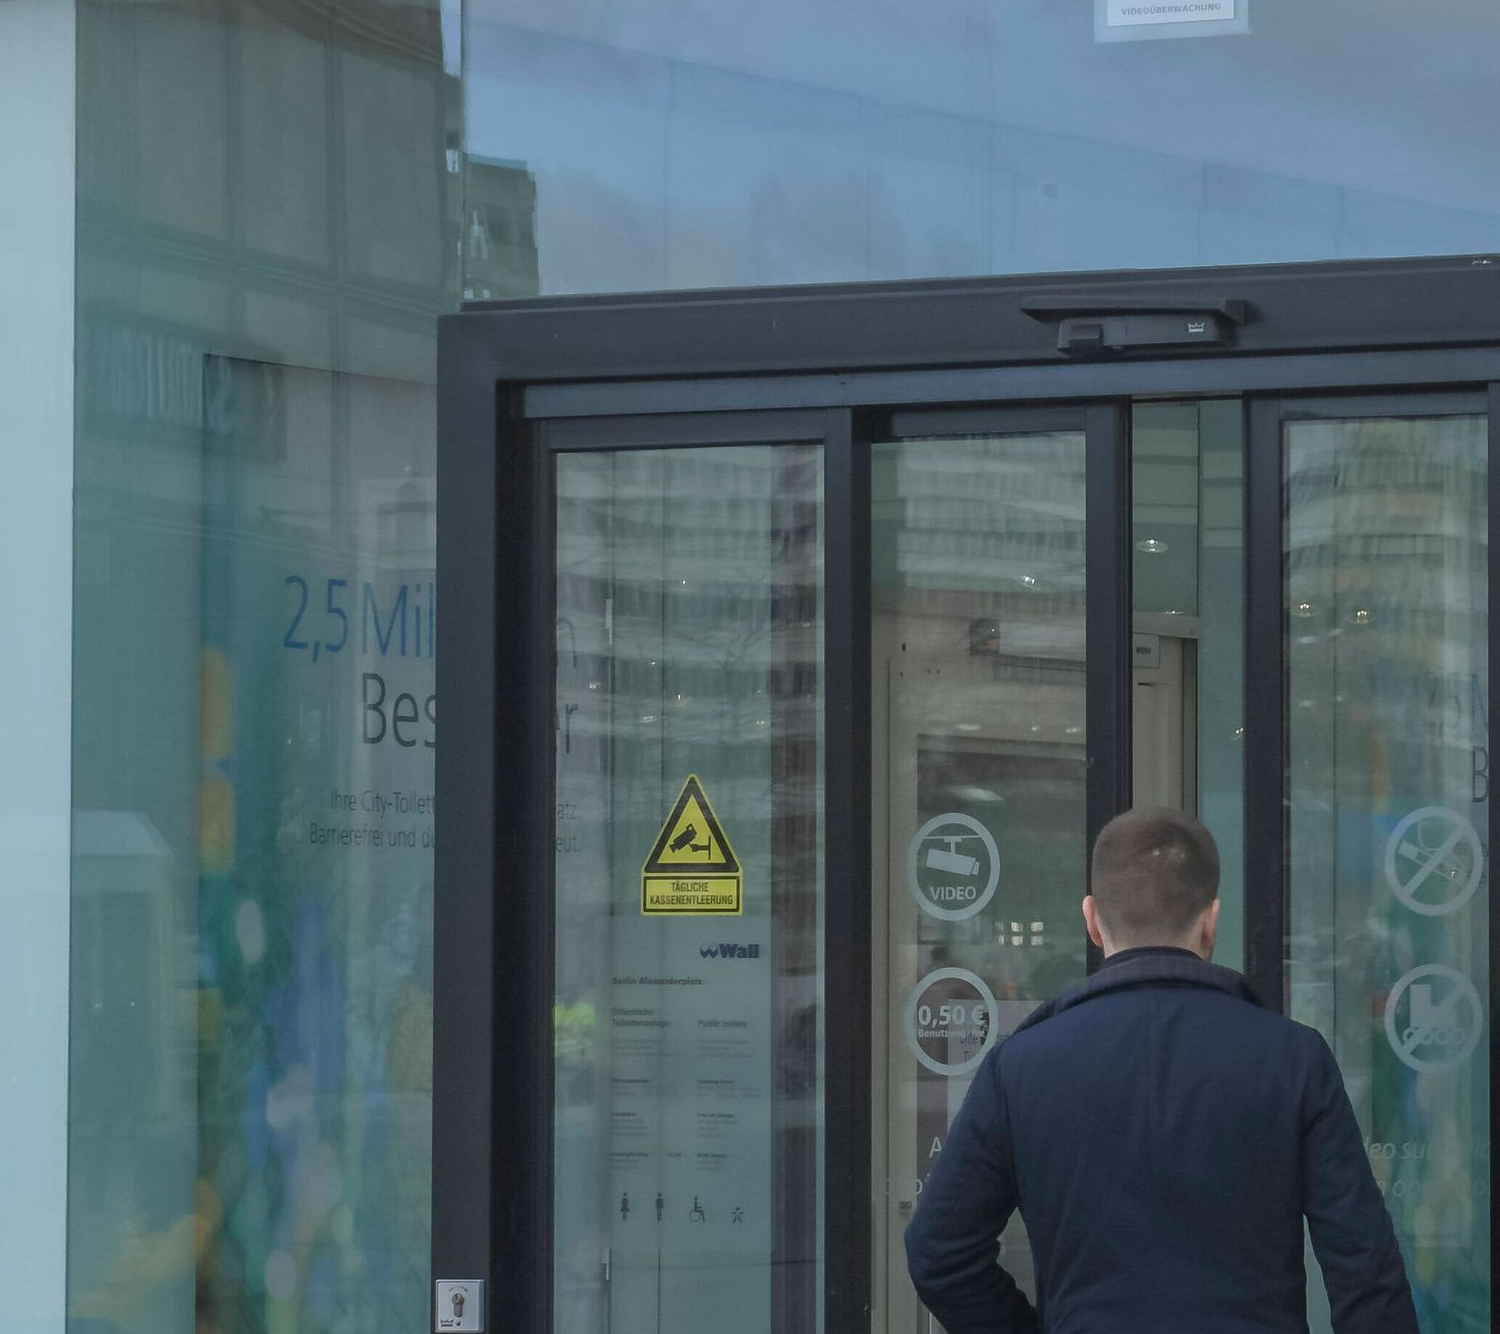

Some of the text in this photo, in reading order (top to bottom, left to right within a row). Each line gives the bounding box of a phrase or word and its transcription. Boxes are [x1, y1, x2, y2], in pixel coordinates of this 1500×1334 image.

[1120, 2, 1222, 17] VIDEOÜBERWACHUNG
[283, 574, 349, 664] 2,5
[330, 788, 357, 812] Ihre
[388, 824, 417, 847] und
[671, 880, 709, 893] TÄGLICHE
[929, 885, 977, 900] VIDEO
[649, 893, 734, 906] KASSENENTLEERUNG
[719, 943, 760, 959] Wall
[612, 976, 637, 986] Berlin
[918, 1004, 985, 1029] 0,50 €
